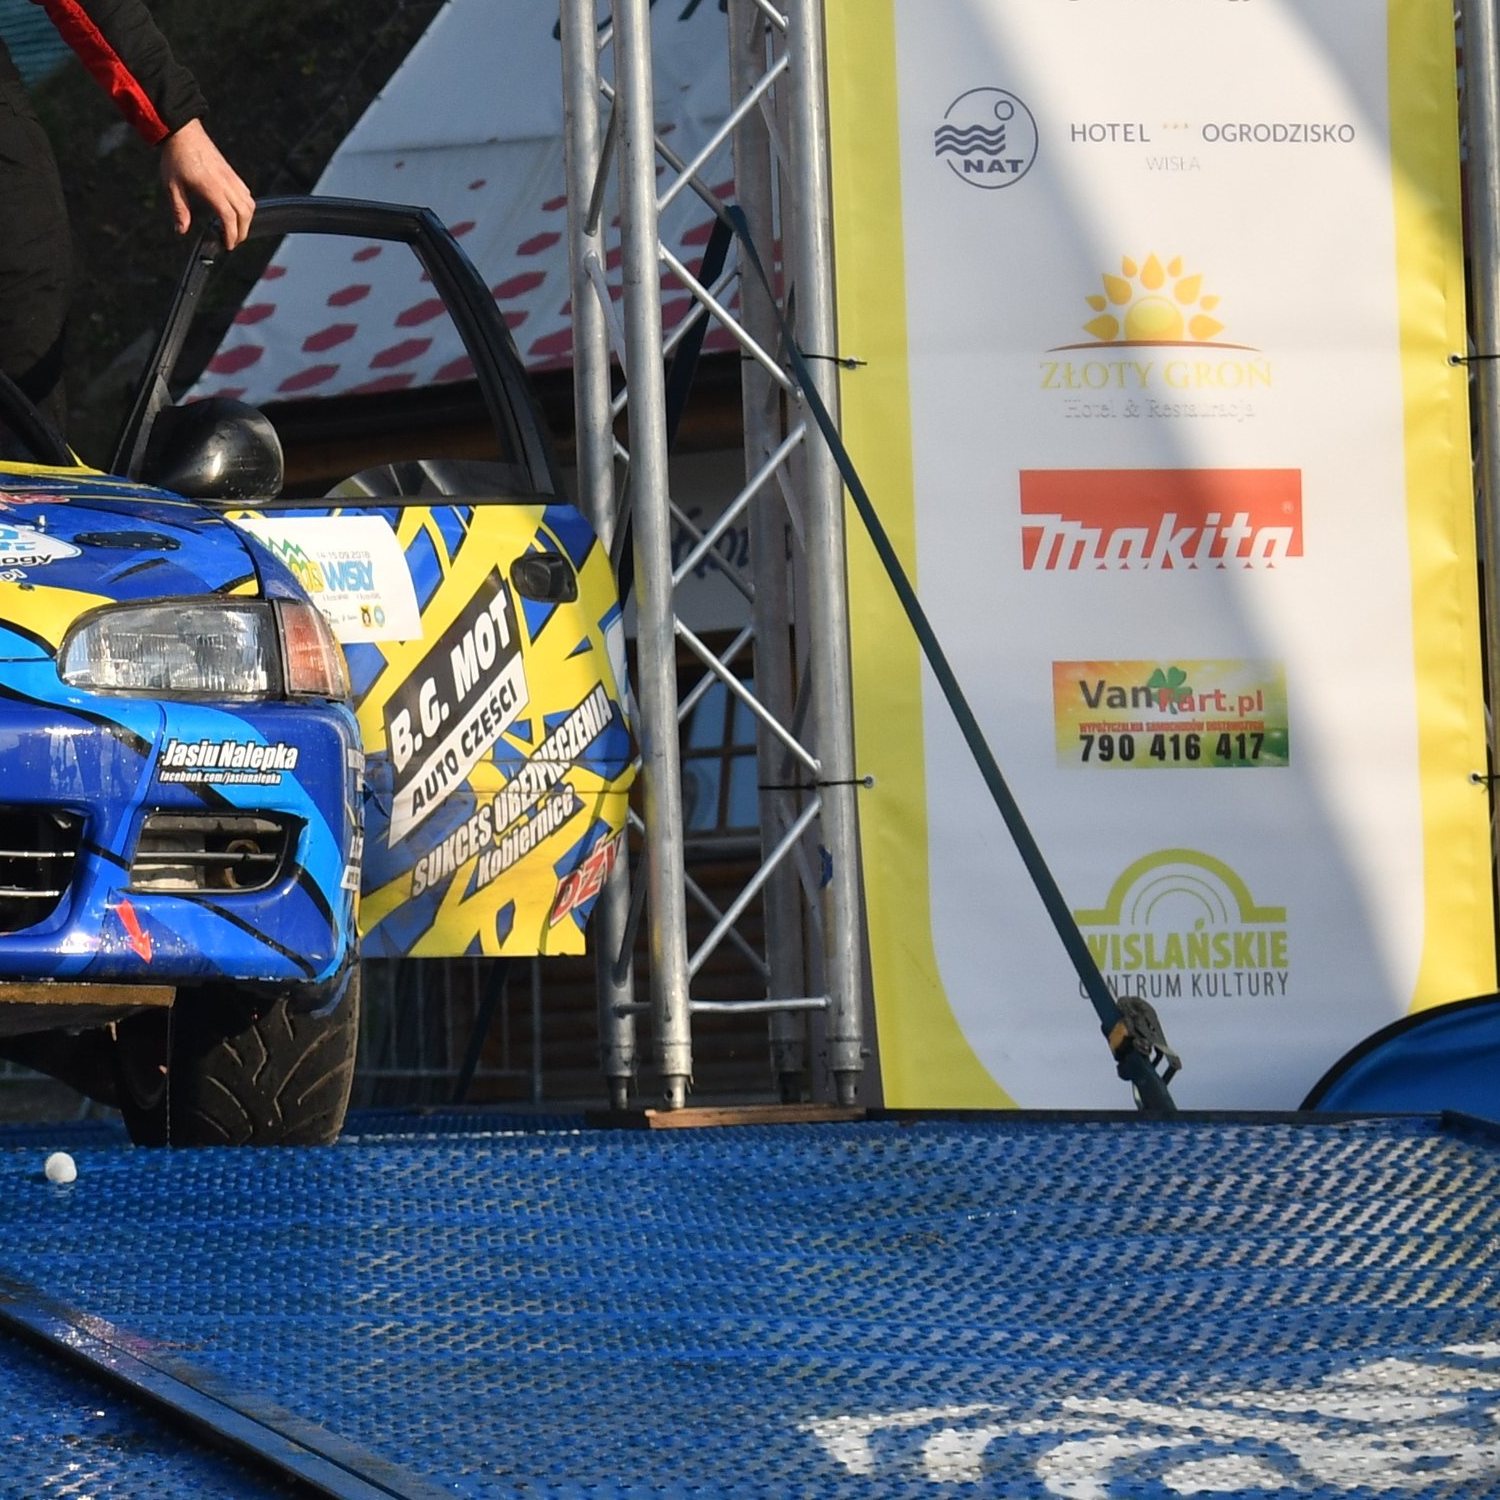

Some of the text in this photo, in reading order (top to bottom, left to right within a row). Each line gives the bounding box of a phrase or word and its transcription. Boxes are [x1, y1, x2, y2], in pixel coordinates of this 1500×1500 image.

[1070, 123, 1356, 144] HOTEL OGRODZISKO
[963, 159, 1024, 173] NAT
[1039, 354, 1273, 390] ZŁOTY GROŃ
[1065, 399, 1117, 419] Hotel
[390, 587, 511, 775] B.G. MOT
[411, 677, 518, 818] AUTO CZĘŚCI
[1079, 732, 1265, 762] 790 416 417
[412, 803, 493, 899] SUKCES
[476, 784, 576, 888] Kobiernice
[1191, 972, 1289, 998] KULTURY
